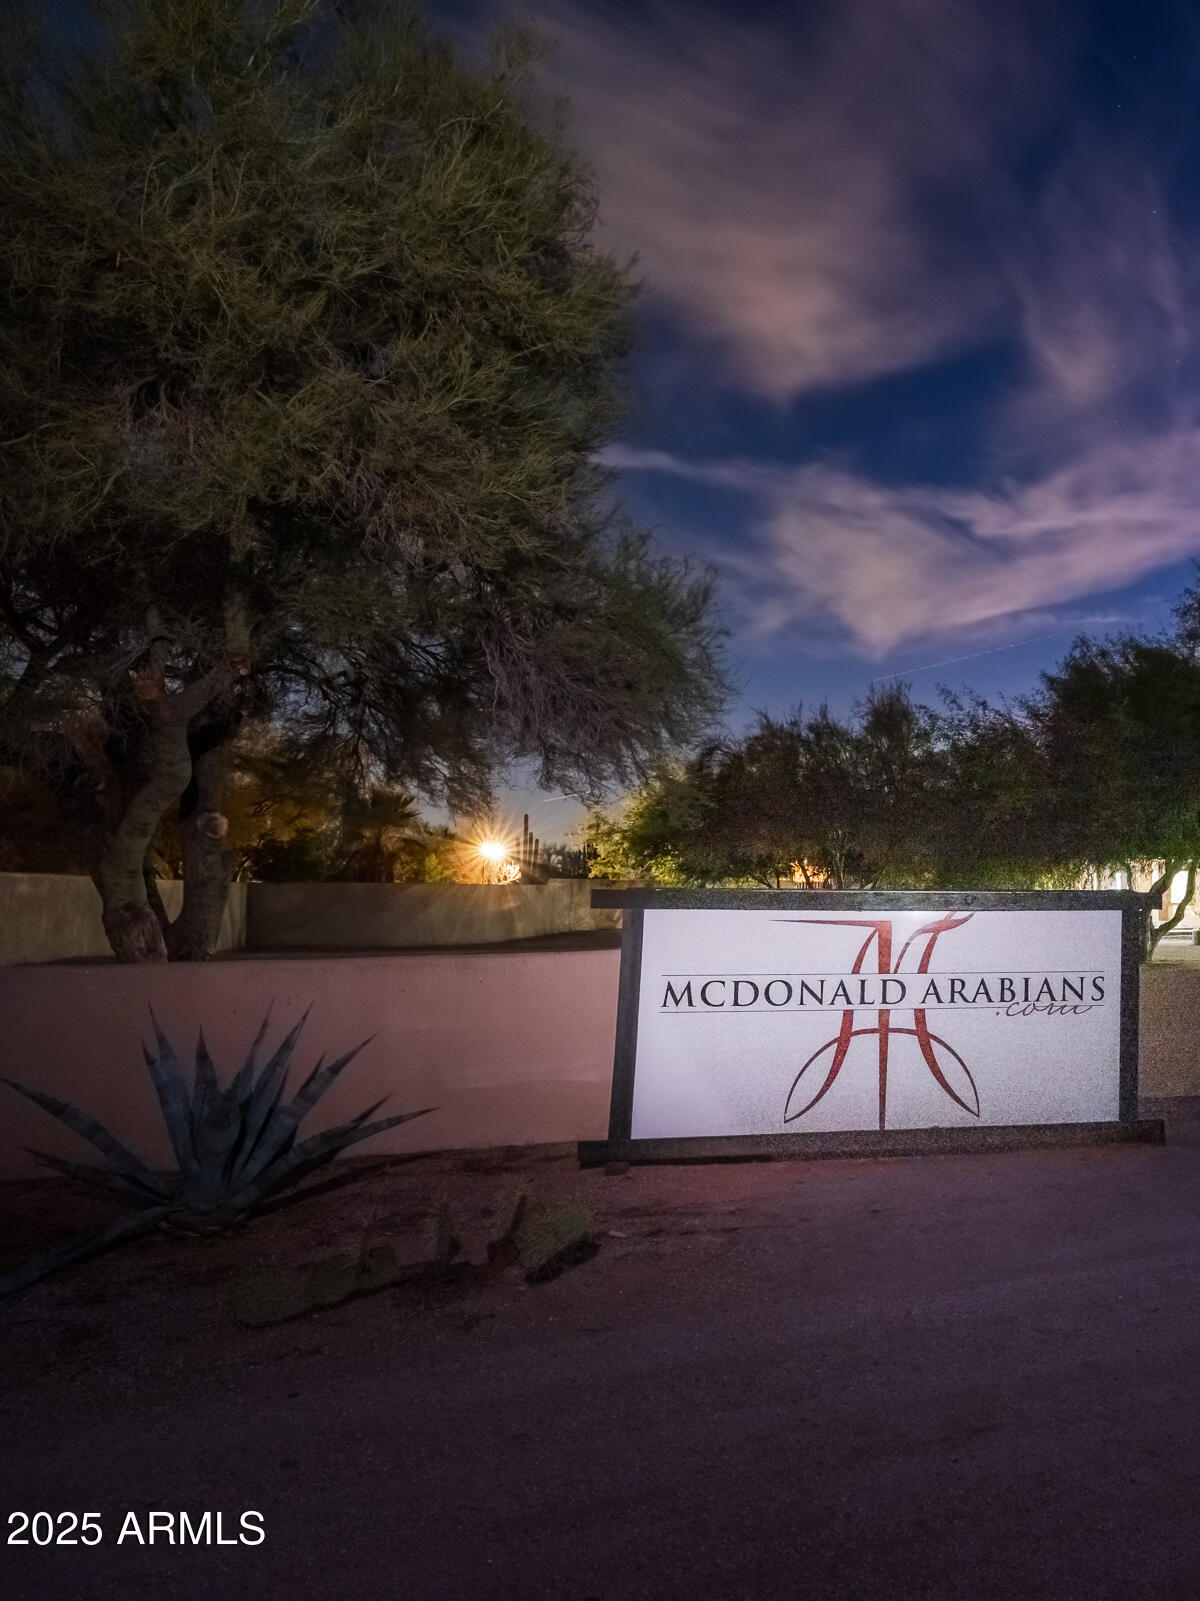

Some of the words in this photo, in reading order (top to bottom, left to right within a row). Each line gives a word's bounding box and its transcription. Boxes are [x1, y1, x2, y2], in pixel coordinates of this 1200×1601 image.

[661, 978, 907, 1008] MCDONALD
[920, 976, 1105, 1005] ARABIANS
[995, 1001, 1093, 1017] .com
